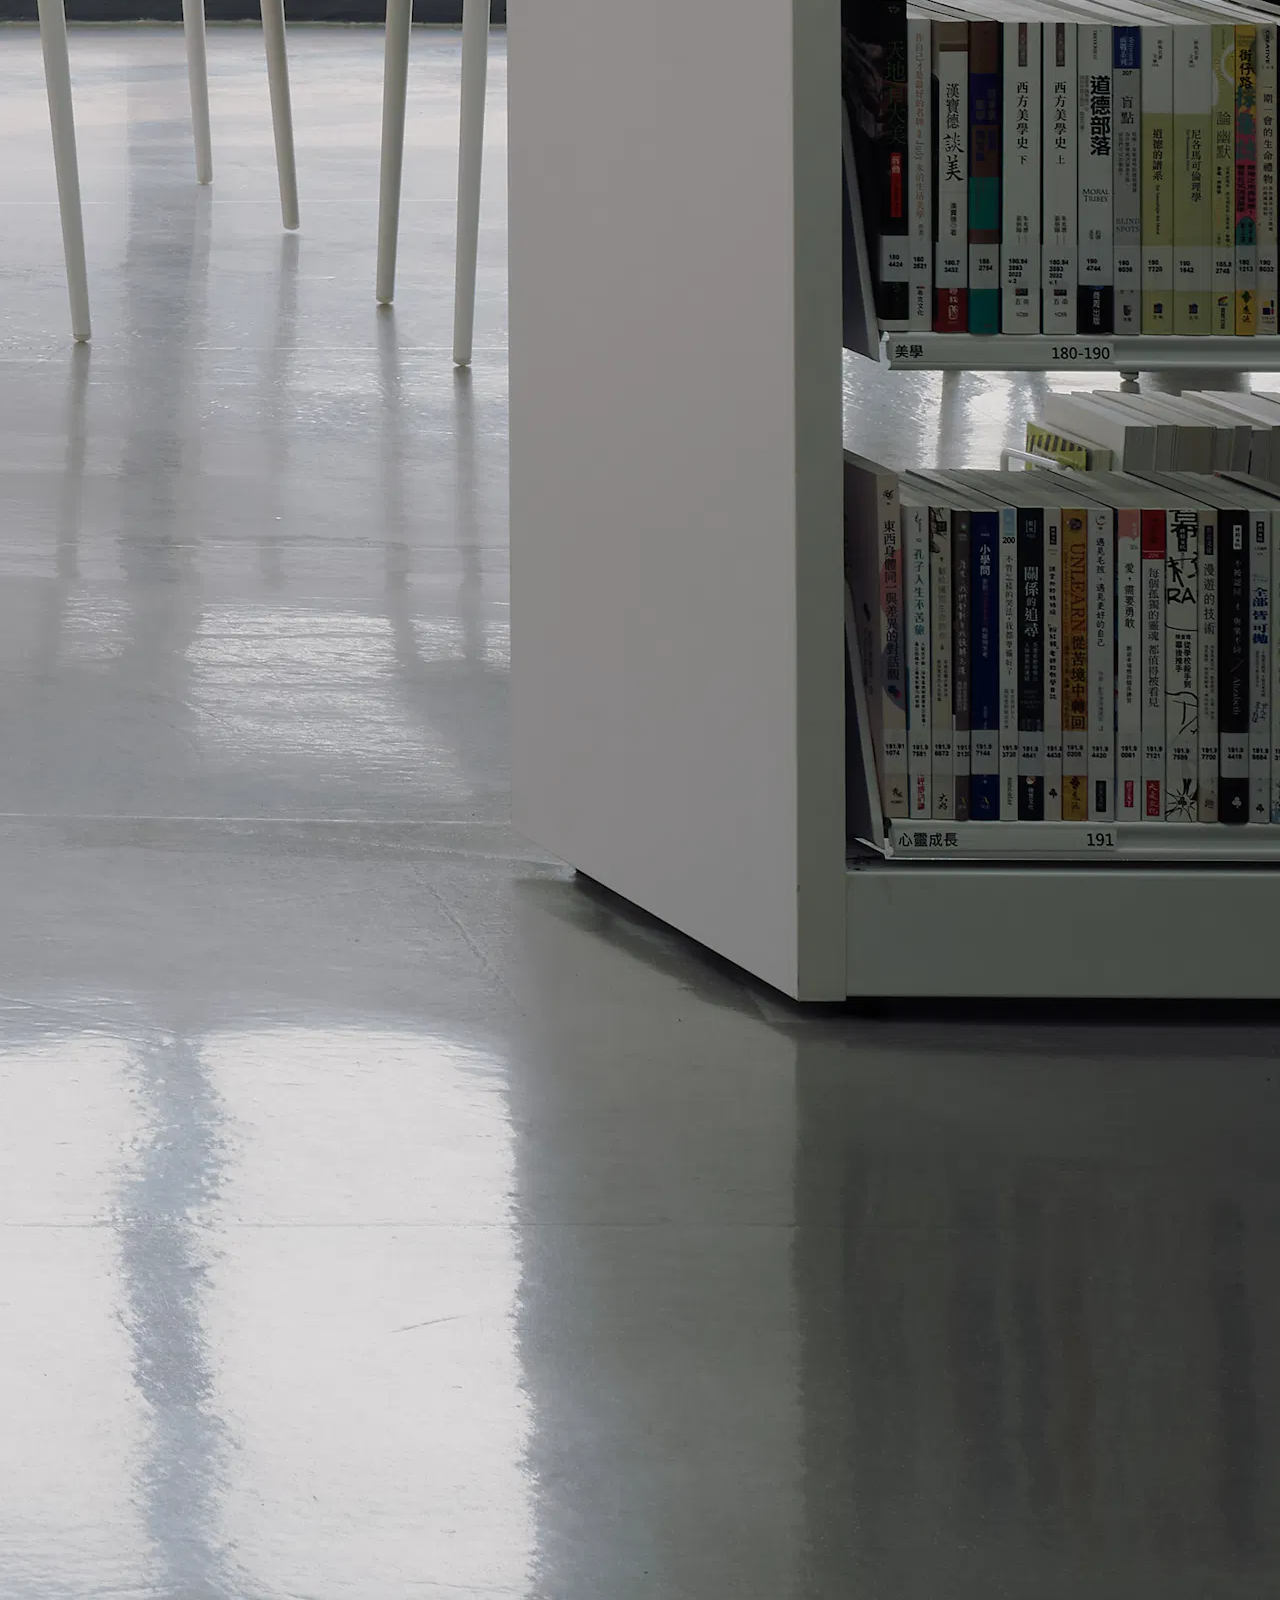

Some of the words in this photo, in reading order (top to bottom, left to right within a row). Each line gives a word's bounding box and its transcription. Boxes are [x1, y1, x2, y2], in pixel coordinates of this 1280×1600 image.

[946, 82, 960, 130] 漢寶德
[1017, 81, 1029, 149] 西方美學史
[1054, 81, 1067, 149] 西方美學史
[1090, 75, 1111, 156] 道德部落
[1120, 96, 1134, 124] 盲點
[943, 132, 965, 182] 談美
[1085, 195, 1109, 203] TRIBES
[895, 344, 923, 359] 美學
[1051, 346, 1110, 360] 180-190
[980, 543, 991, 576] 小學問
[1003, 536, 1016, 544] 200
[1024, 566, 1039, 639] 關係的追尋
[1204, 563, 1215, 635] 漫遊的技術
[898, 832, 958, 847] 心靈成長
[1086, 833, 1114, 846] 191
